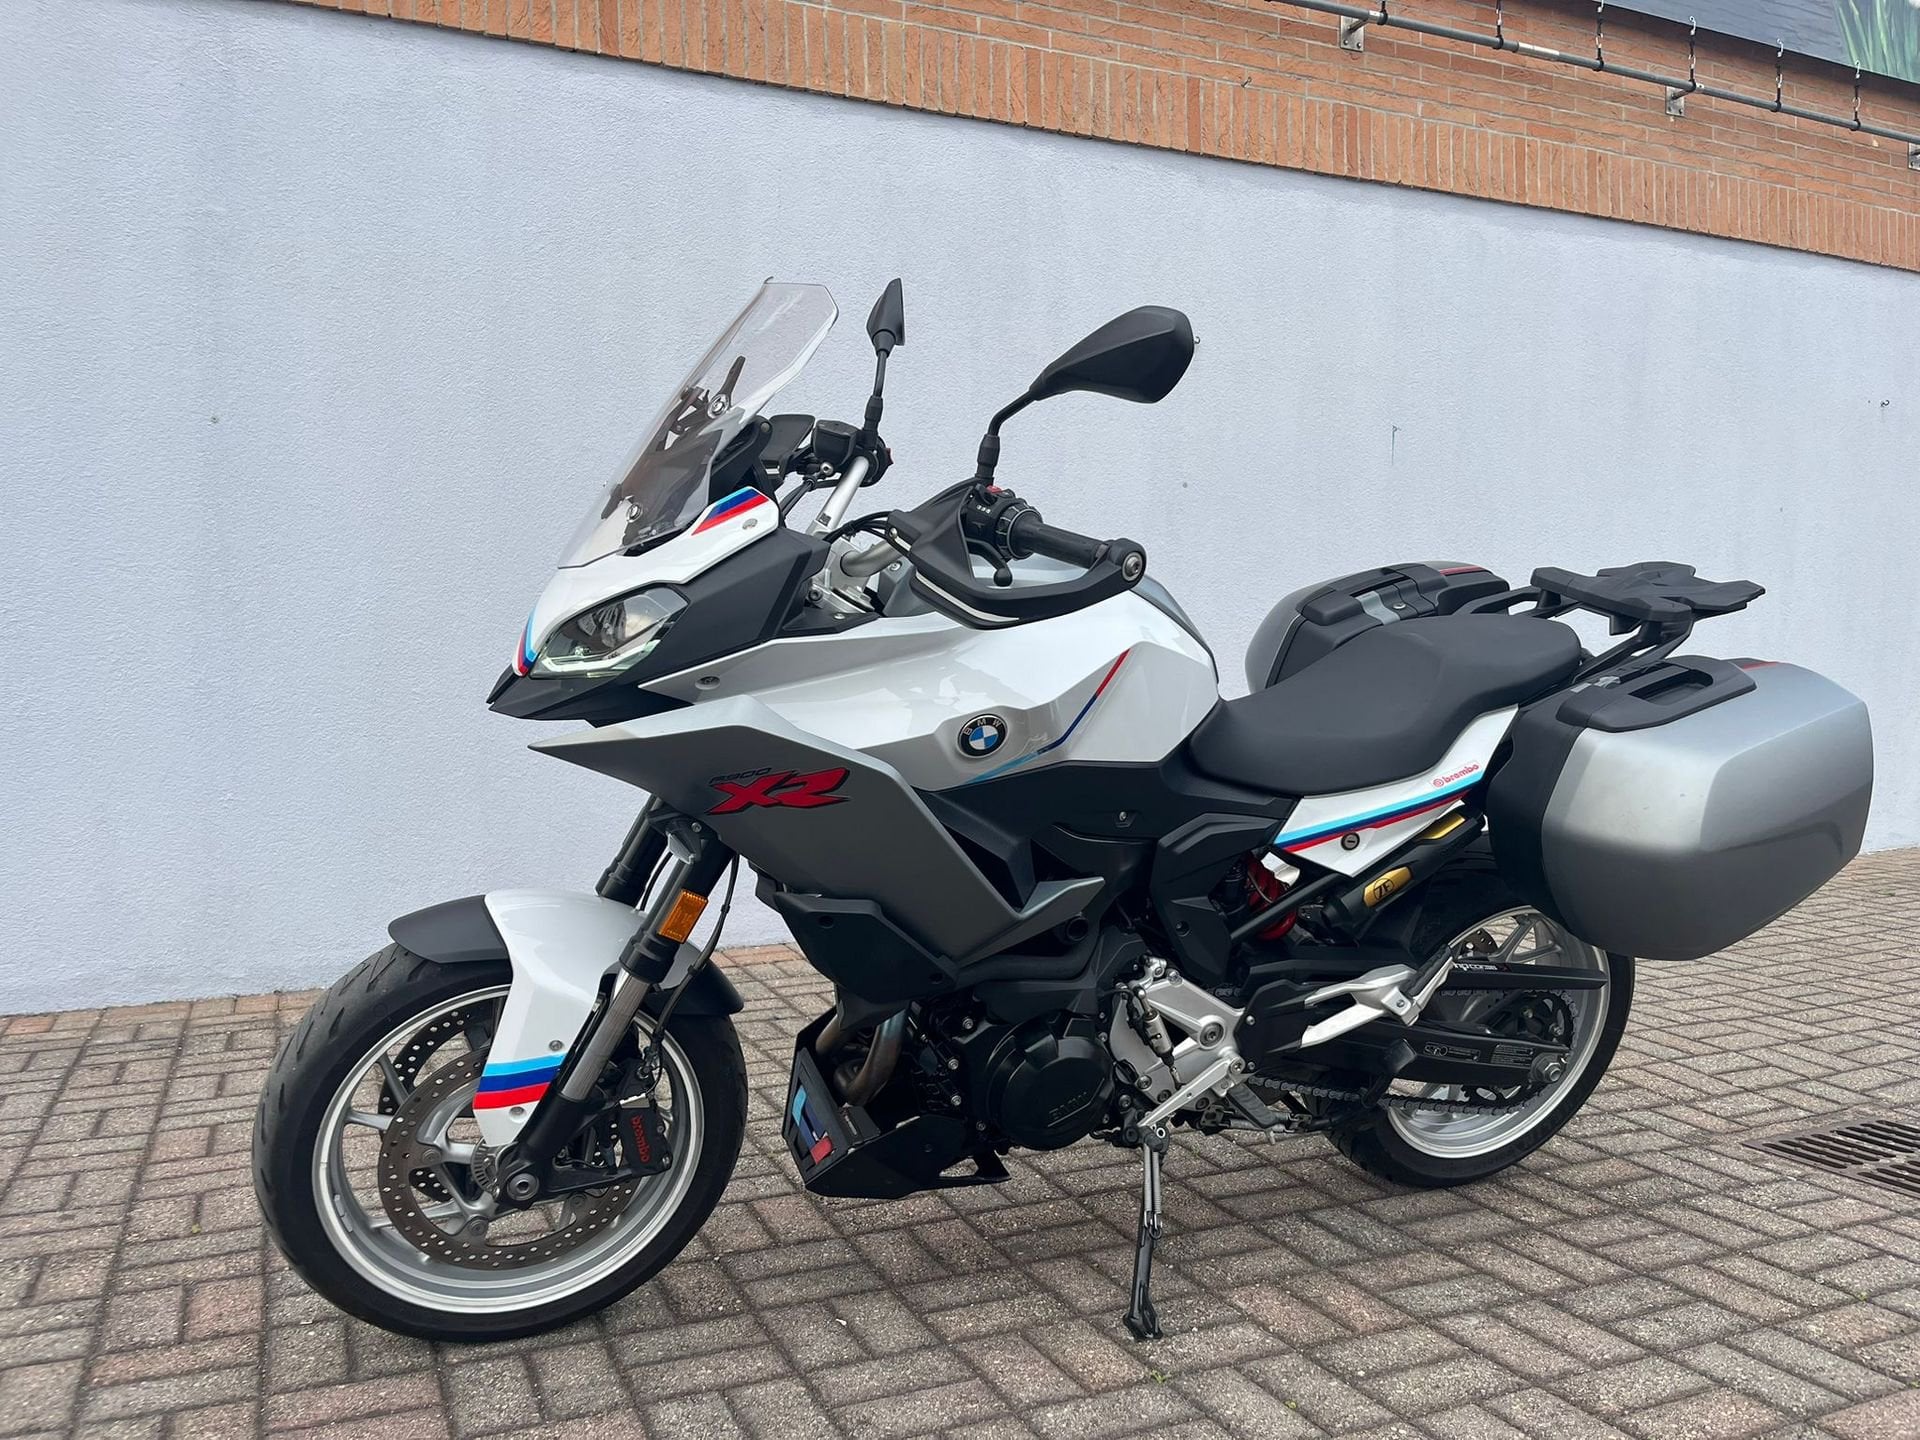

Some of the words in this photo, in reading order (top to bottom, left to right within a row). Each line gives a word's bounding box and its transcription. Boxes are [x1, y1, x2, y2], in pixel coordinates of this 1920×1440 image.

[963, 718, 1002, 735] BMW
[1442, 764, 1479, 783] brembo
[631, 1115, 650, 1164] brembo
